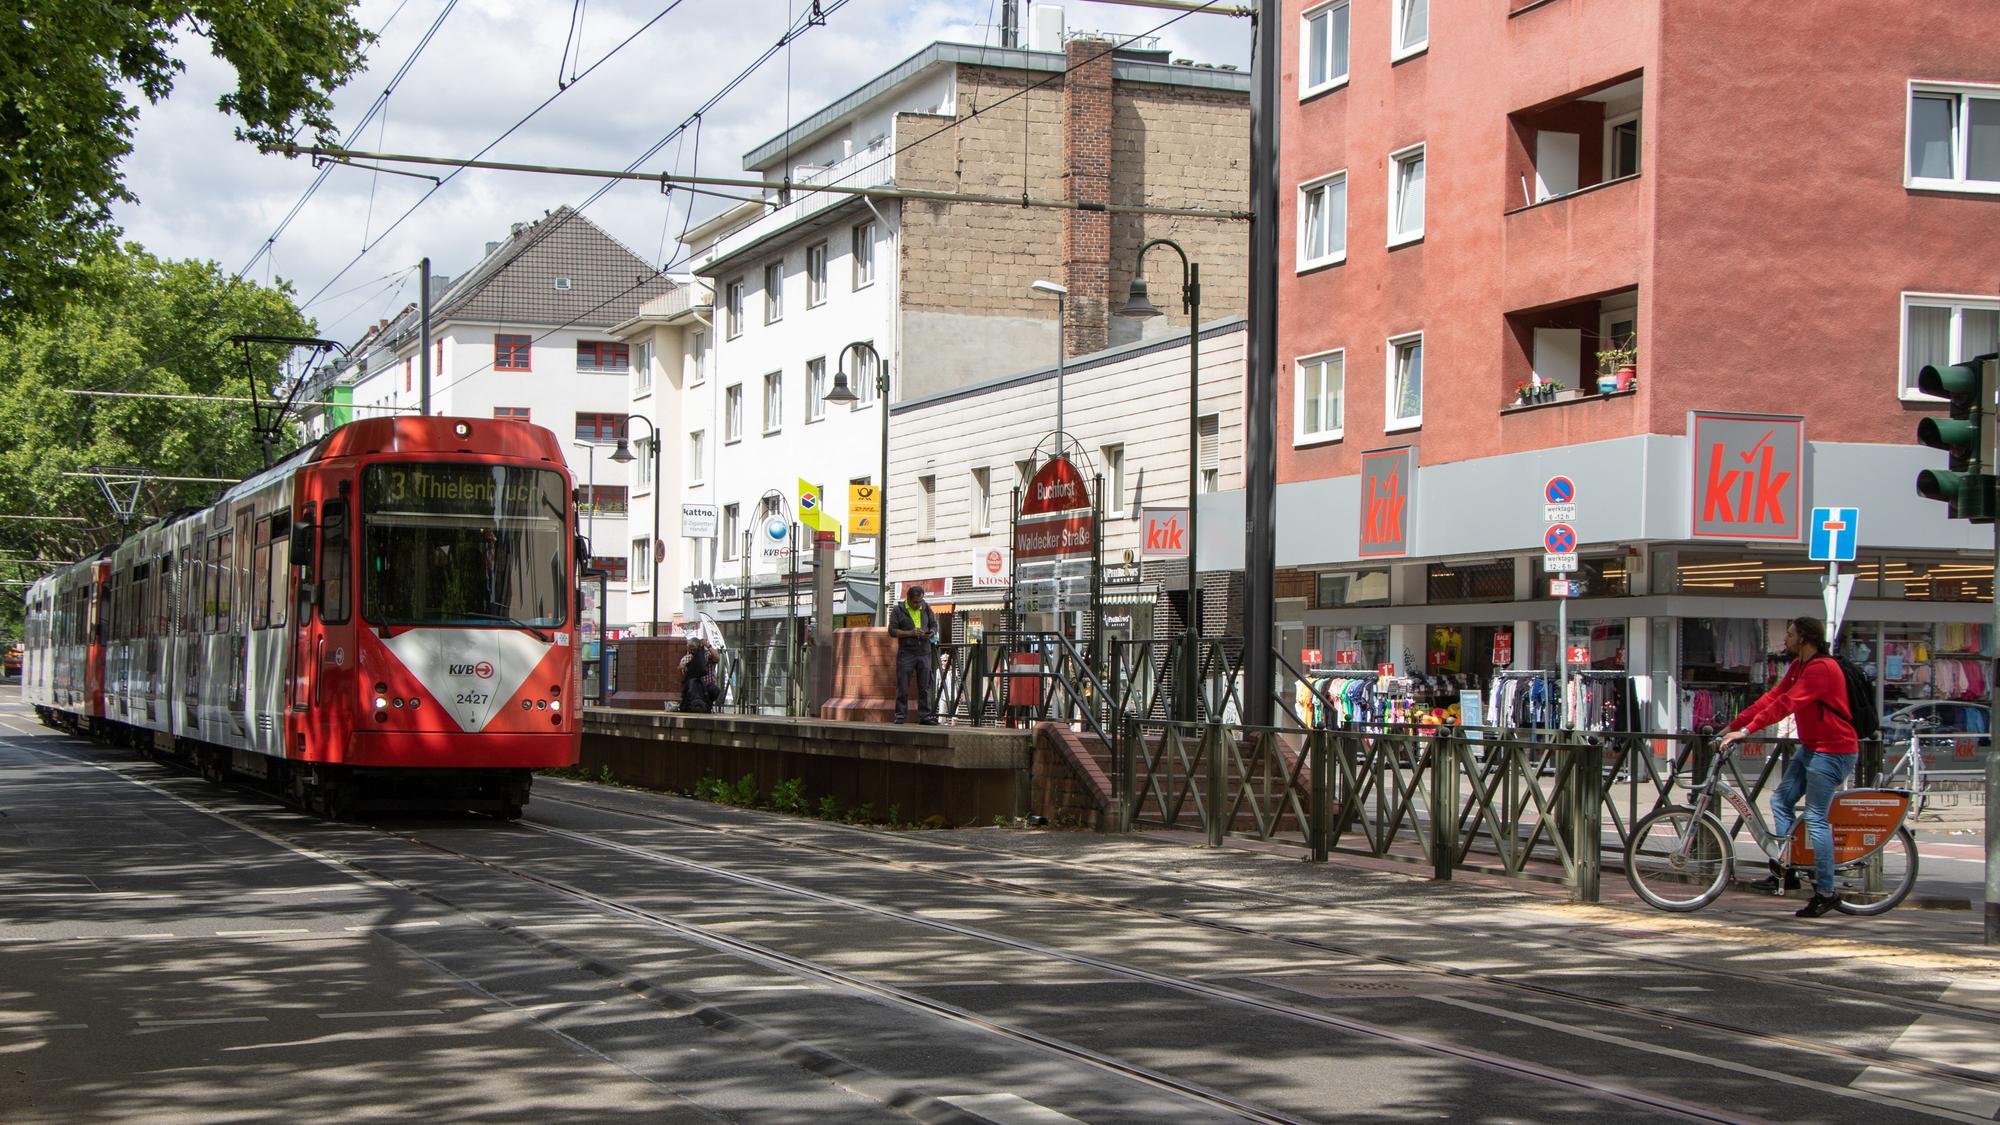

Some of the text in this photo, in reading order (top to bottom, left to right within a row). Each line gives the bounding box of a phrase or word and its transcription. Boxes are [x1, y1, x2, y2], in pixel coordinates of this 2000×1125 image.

[391, 472, 405, 500] 3
[1037, 479, 1075, 500] Buchforst
[1703, 430, 1791, 525] kik
[1365, 462, 1405, 544] kik
[1018, 527, 1090, 551] Waldecker Straße
[1147, 514, 1184, 549] kik
[978, 576, 1010, 585] KIOSK
[449, 664, 474, 675] KVB
[456, 693, 489, 705] 2427
